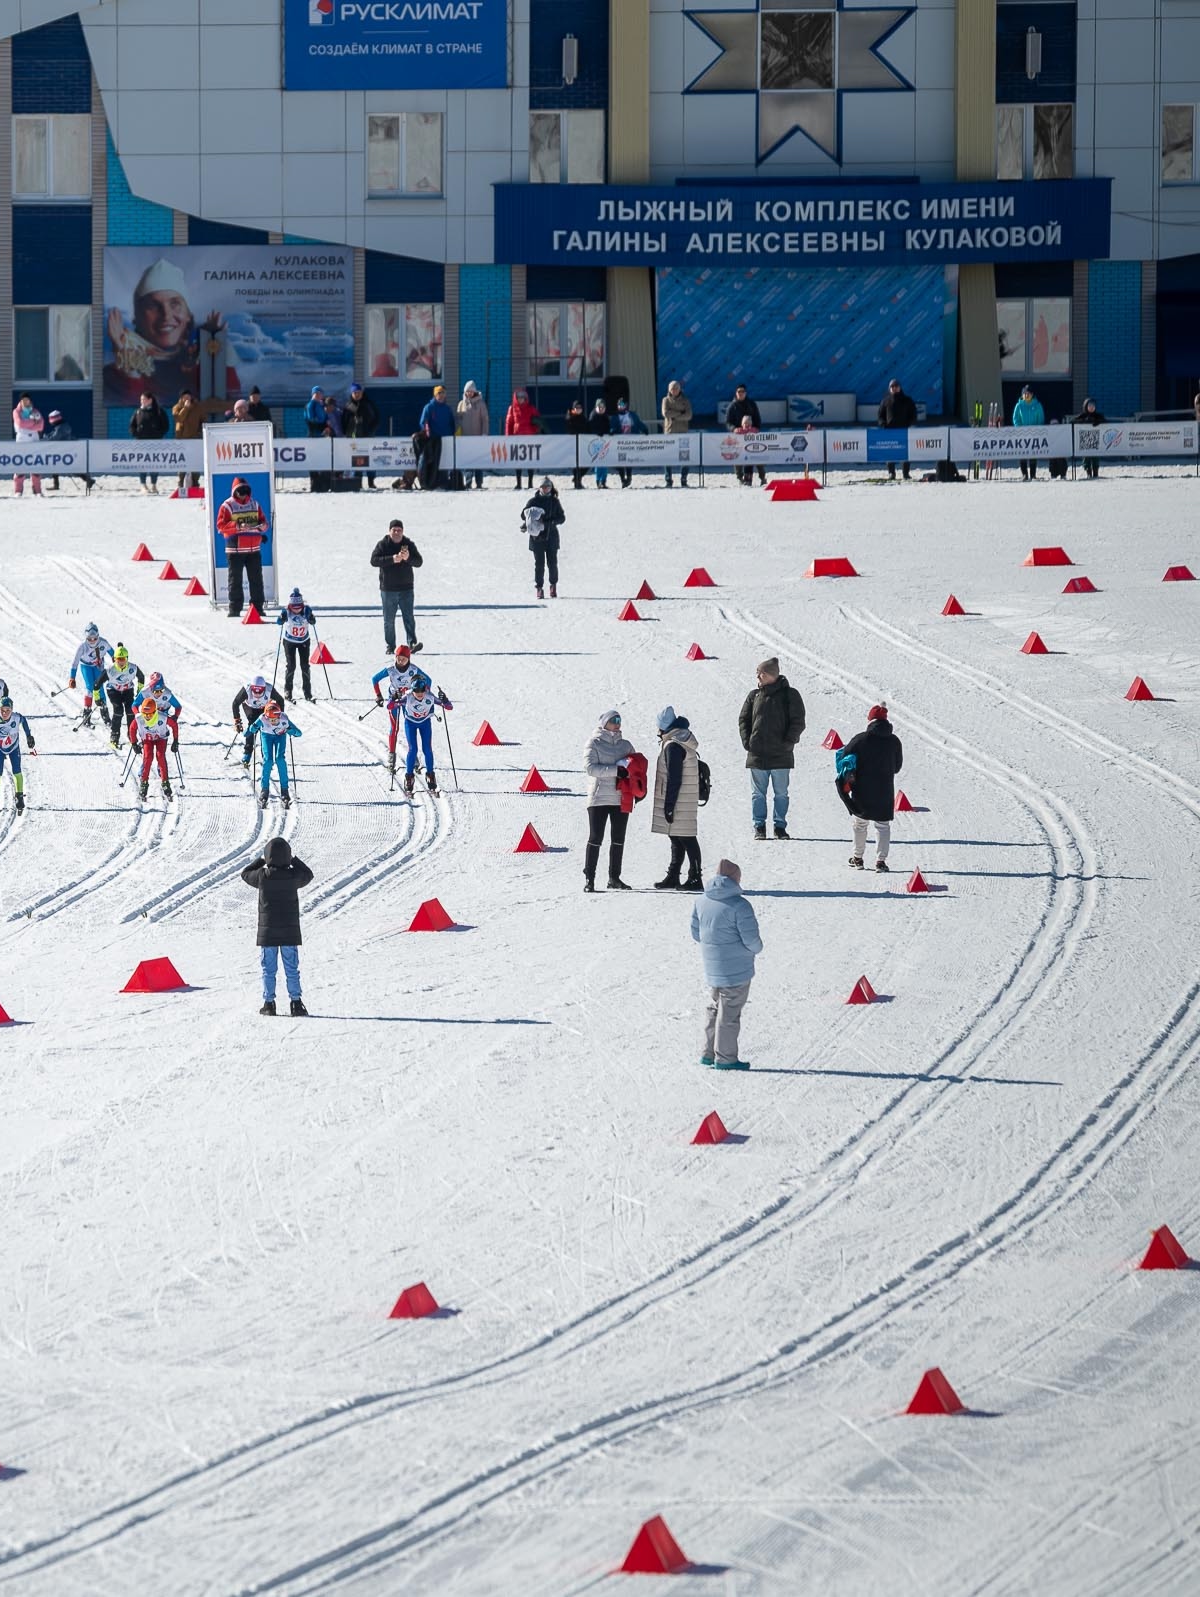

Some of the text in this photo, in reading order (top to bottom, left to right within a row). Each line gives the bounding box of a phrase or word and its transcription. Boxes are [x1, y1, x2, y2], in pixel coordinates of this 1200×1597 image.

[340, 2, 483, 20] РУСКЛИМАТ
[308, 43, 482, 56] СОЗДАЁМ КЛИМАТ В СТРАНЕ
[597, 196, 1015, 222] ЛЫЖНЫЙ КОМПЛЕКС ИМЕНИ
[552, 221, 1062, 253] ГАЛИНЫ АЛЕКСЕЕВНЫ КУЛАКОВОЙ
[274, 255, 345, 266] КУЛАКОВА
[204, 270, 345, 281] ГАЛИНА АЛЕКСЕЕВНА
[235, 288, 345, 296] ПОБЕДЫ НА ОЛИМПИАДАХ
[842, 441, 859, 451] ИЗТТ
[925, 439, 942, 449] ИЗТТ
[973, 437, 1049, 450] БАРРАКУДА
[234, 442, 264, 459] ИЗТТ
[510, 444, 542, 461] ИЗТТ
[112, 452, 186, 463] БАРРАКУДА
[291, 626, 306, 637] 82
